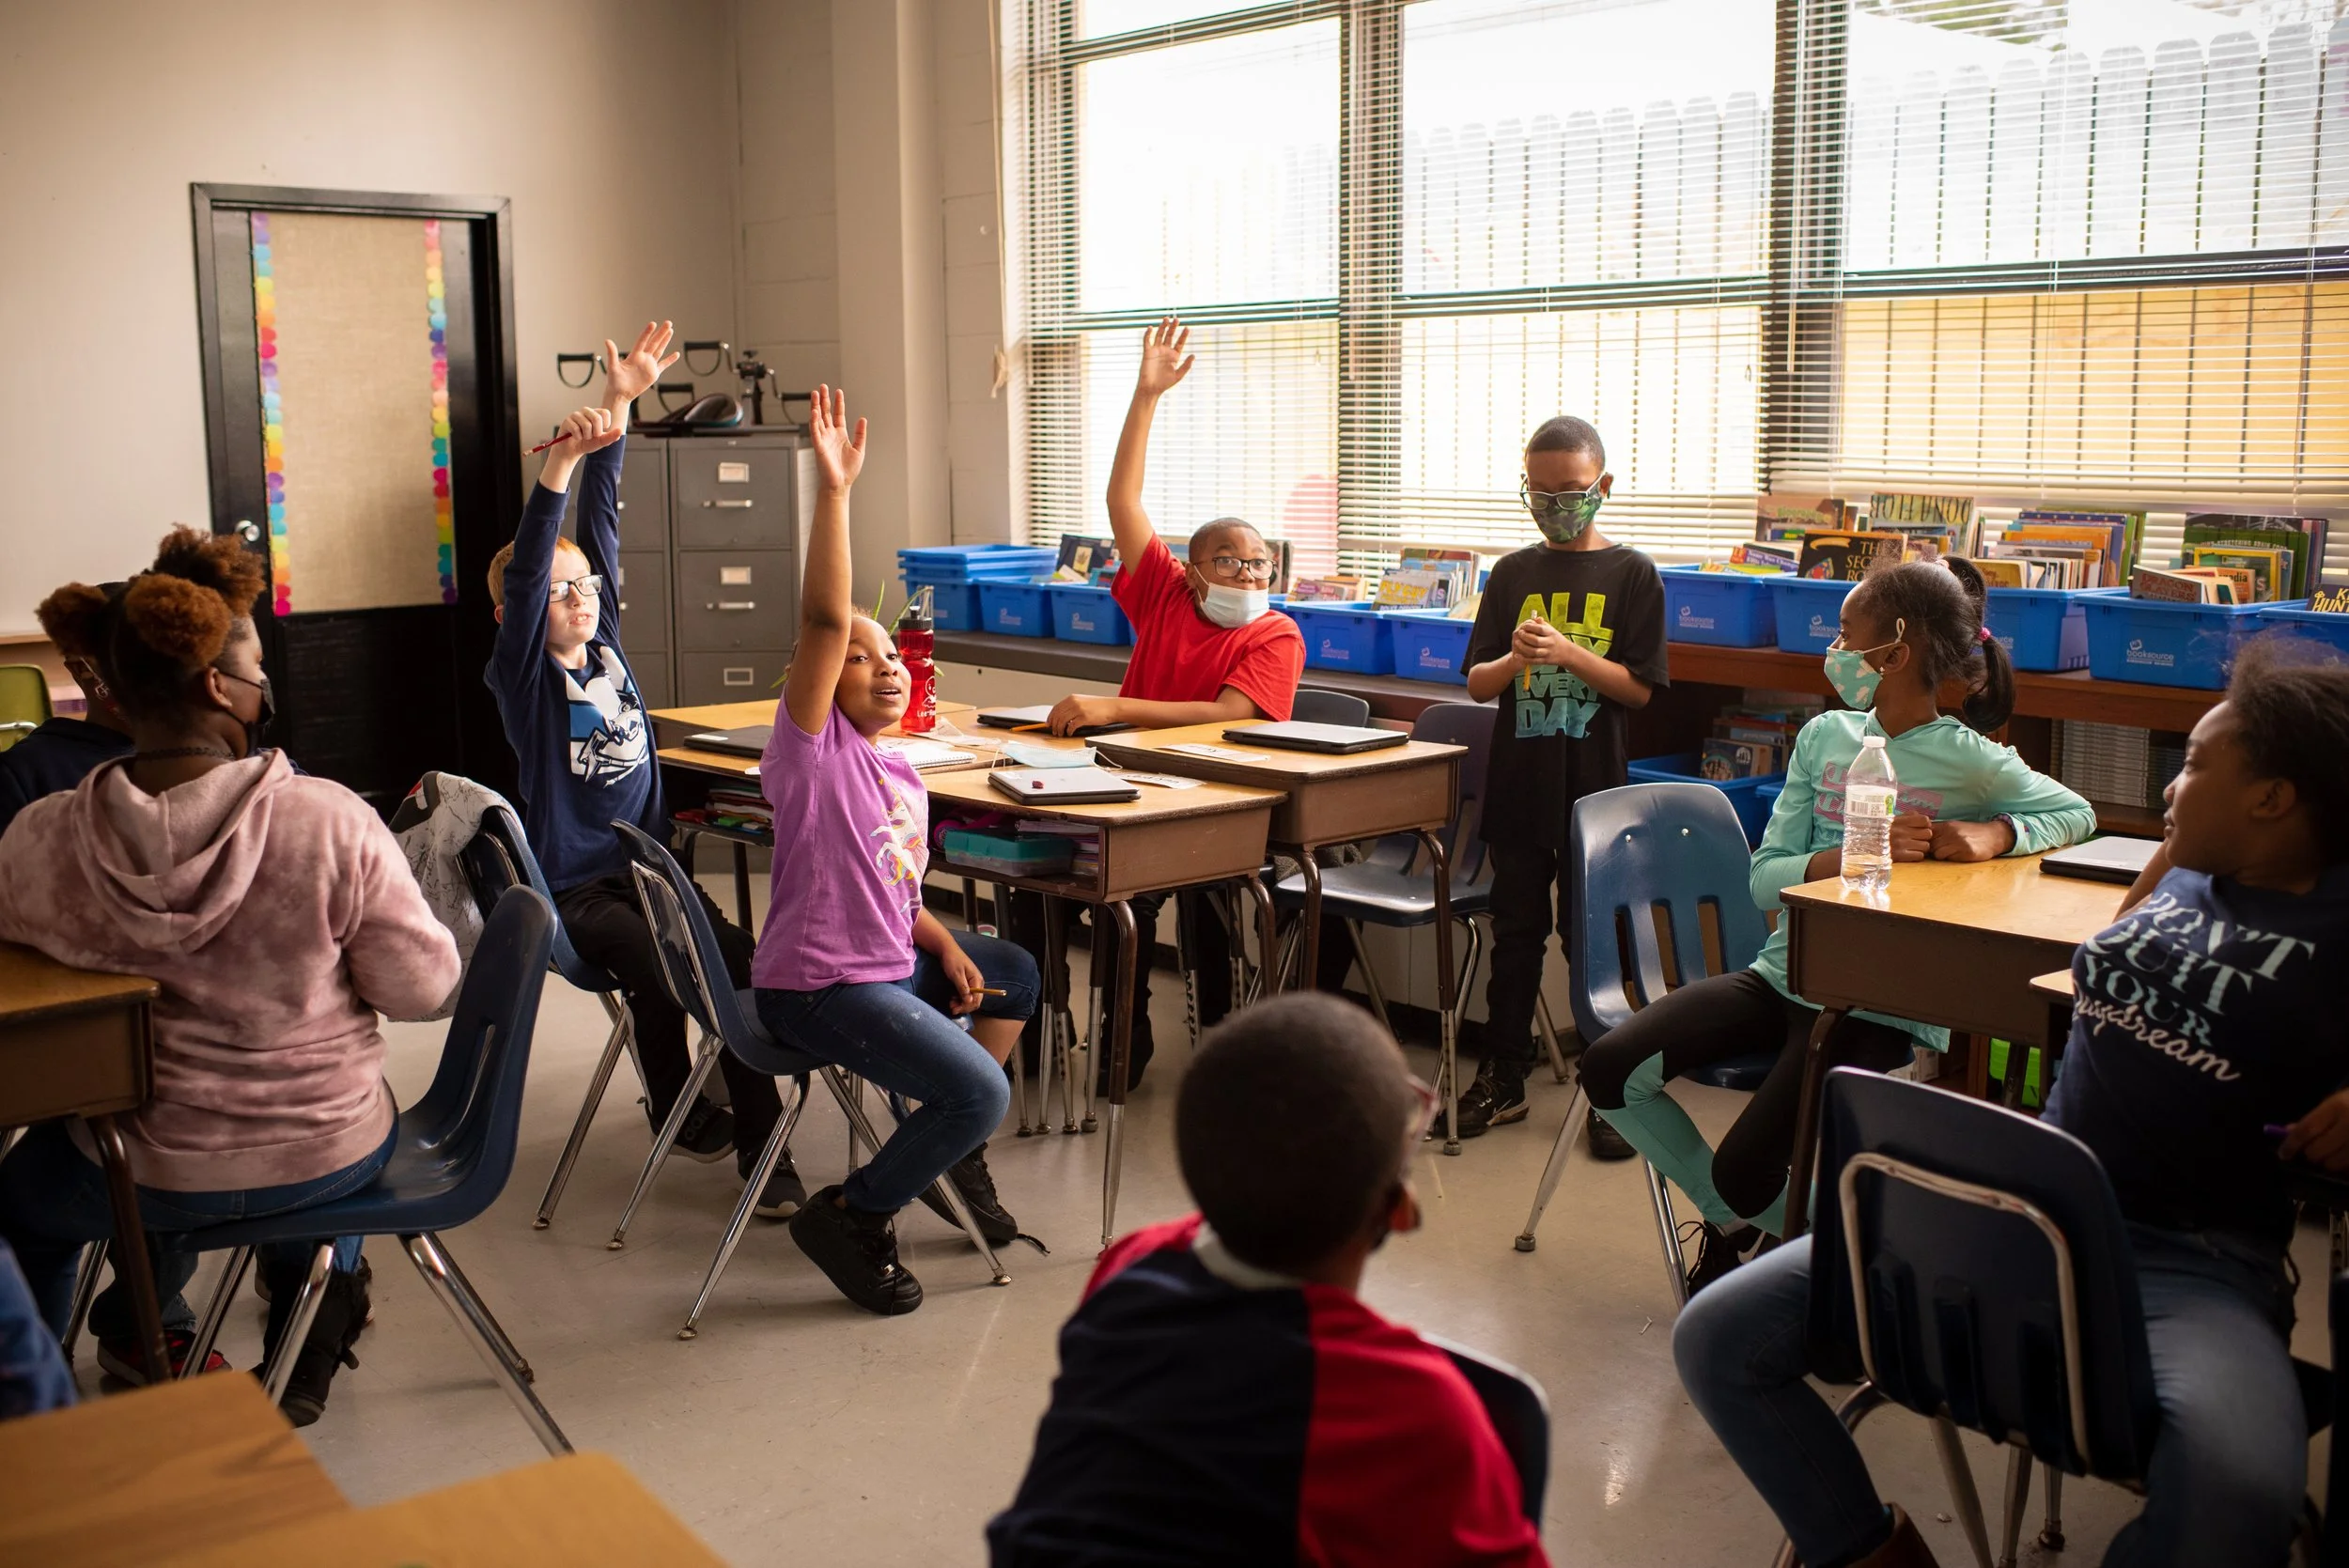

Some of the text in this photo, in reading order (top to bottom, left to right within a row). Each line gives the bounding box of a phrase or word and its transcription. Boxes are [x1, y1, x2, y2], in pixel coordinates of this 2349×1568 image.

[1845, 554, 1873, 569] SEC
[1859, 541, 1880, 556] TH
[2141, 572, 2195, 592] DRAGON
[1516, 592, 1614, 642] ALL
[2126, 648, 2174, 660] booksource
[1516, 696, 1601, 738] DAY
[2085, 916, 2253, 1016] QUIT
[2084, 953, 2213, 1047] YOUR
